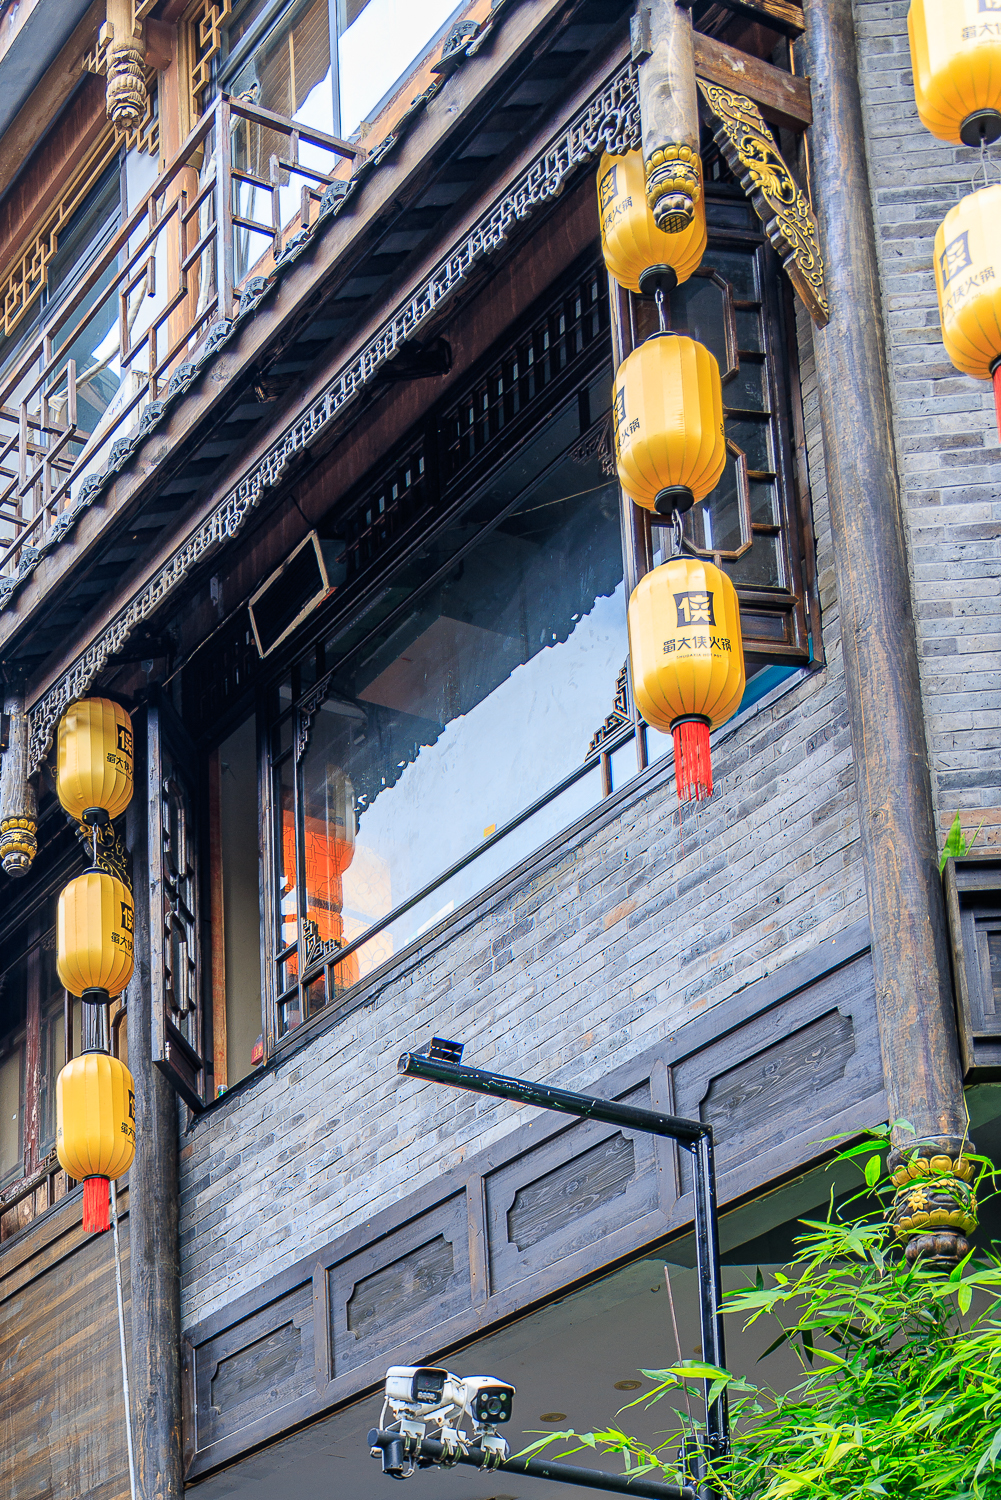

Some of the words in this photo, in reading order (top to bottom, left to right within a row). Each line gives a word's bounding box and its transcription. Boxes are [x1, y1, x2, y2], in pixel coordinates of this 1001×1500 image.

[942, 266, 995, 320] 大侠火锅
[677, 593, 713, 624] 侠
[663, 635, 732, 655] 蜀大侠火锅
